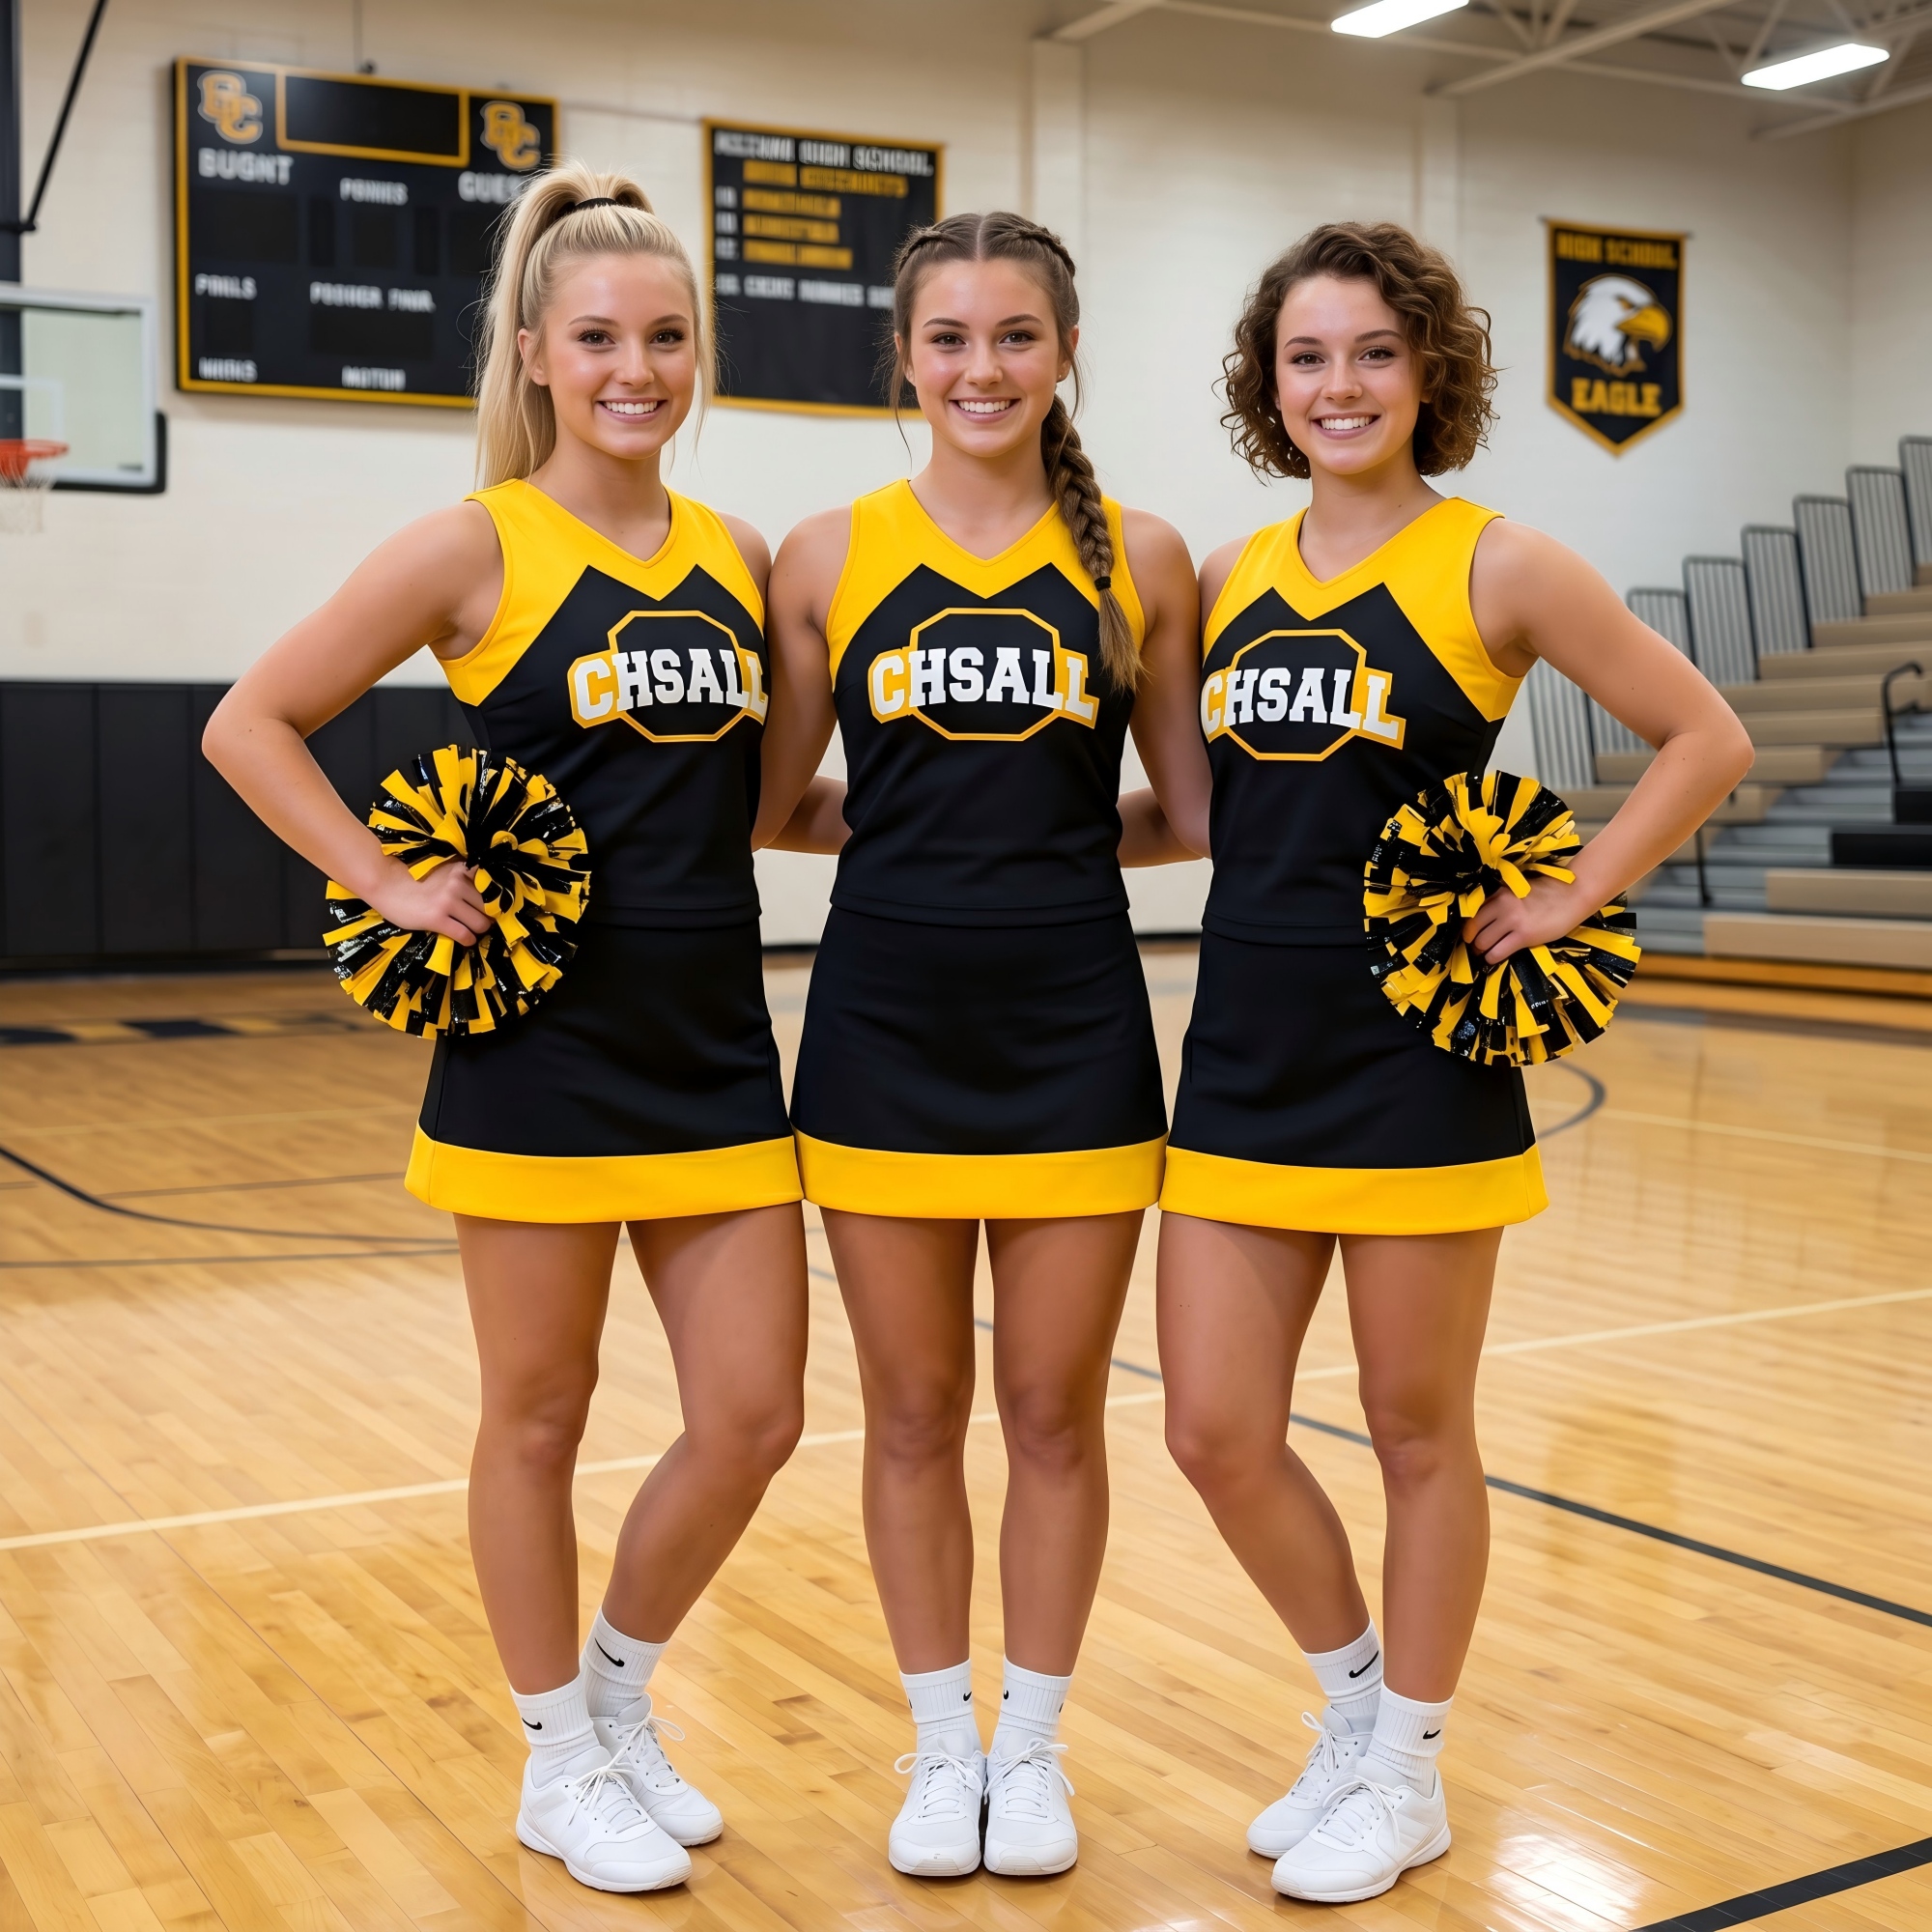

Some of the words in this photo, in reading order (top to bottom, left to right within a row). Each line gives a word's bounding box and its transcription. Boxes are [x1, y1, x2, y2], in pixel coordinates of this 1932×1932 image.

[1572, 377, 1662, 417] EAGLE
[872, 646, 1094, 721] CHSALL
[1200, 668, 1400, 741] CHSALL
